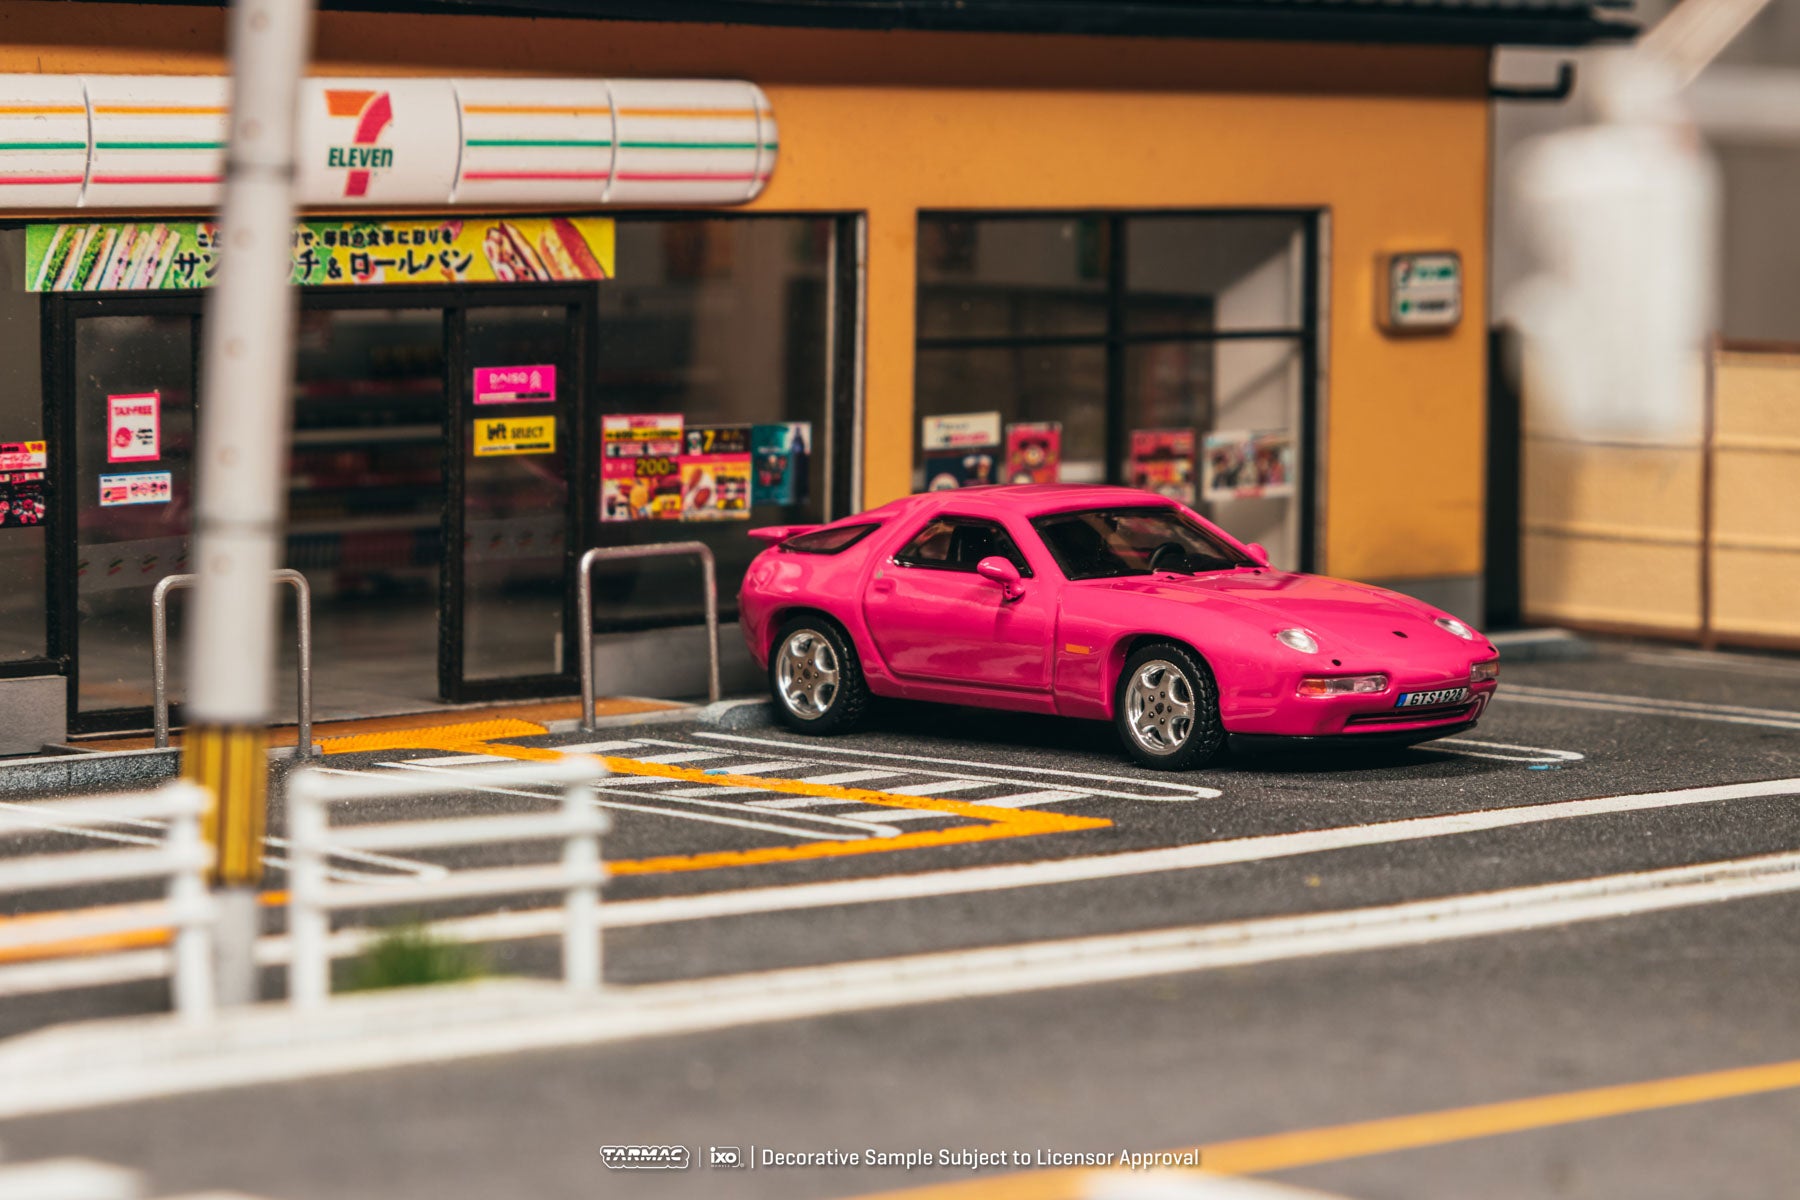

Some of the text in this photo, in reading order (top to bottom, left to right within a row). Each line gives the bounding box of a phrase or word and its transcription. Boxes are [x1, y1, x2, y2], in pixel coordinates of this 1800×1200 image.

[324, 89, 393, 197] 7
[327, 257, 342, 279] &
[350, 249, 473, 276] ロールパン
[511, 427, 544, 439] SELECT
[1410, 689, 1463, 705] GTS 928
